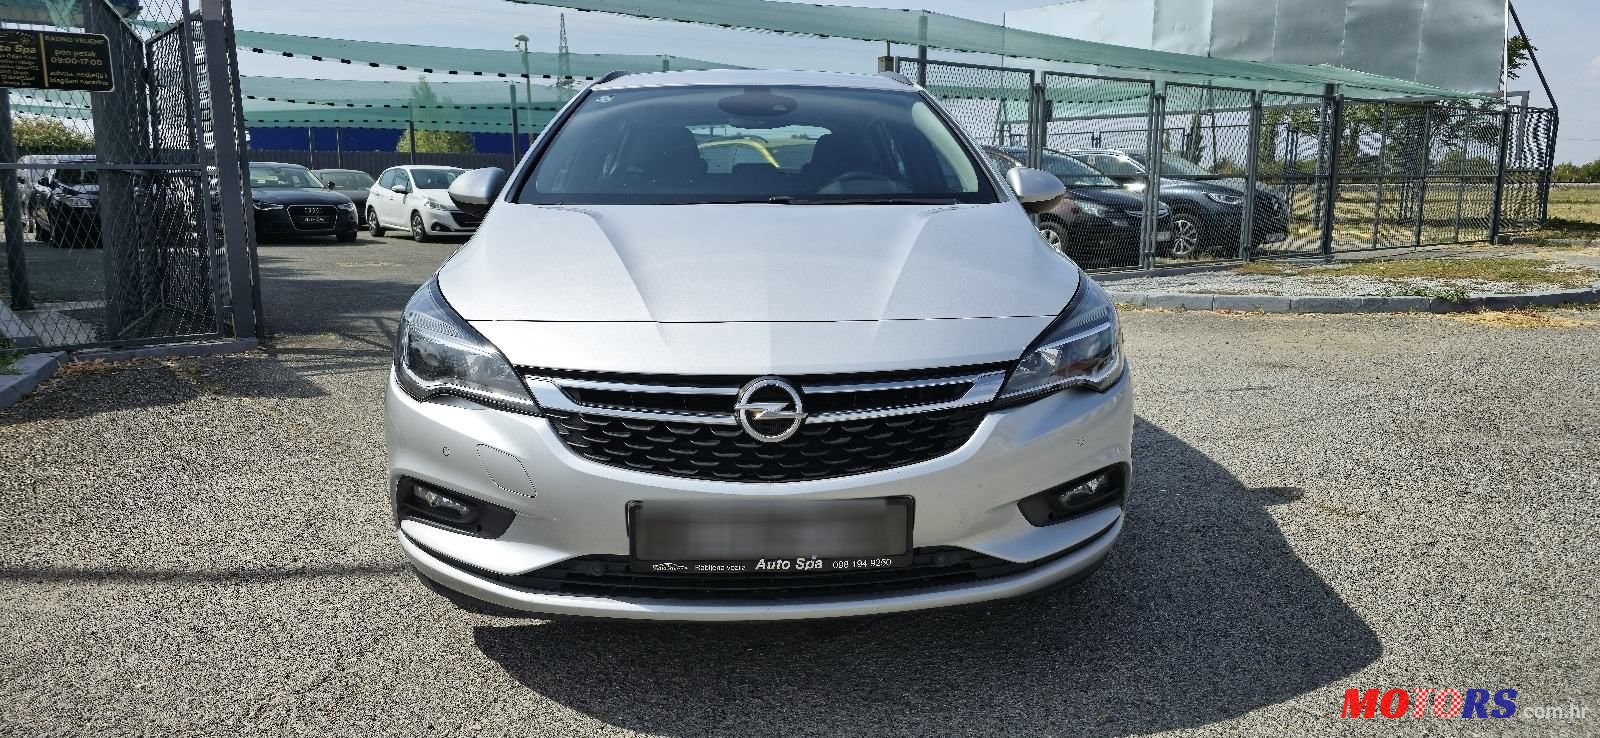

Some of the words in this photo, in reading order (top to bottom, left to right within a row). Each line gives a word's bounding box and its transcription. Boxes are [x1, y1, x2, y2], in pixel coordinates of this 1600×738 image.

[45, 35, 72, 43] RADNO
[74, 37, 104, 45] VRIJEME
[15, 44, 37, 54] Spa
[50, 57, 103, 66] 09:00-17:00
[755, 558, 791, 570] Auto
[795, 557, 823, 571] Spa
[832, 560, 849, 569] 098
[852, 559, 868, 568] 194
